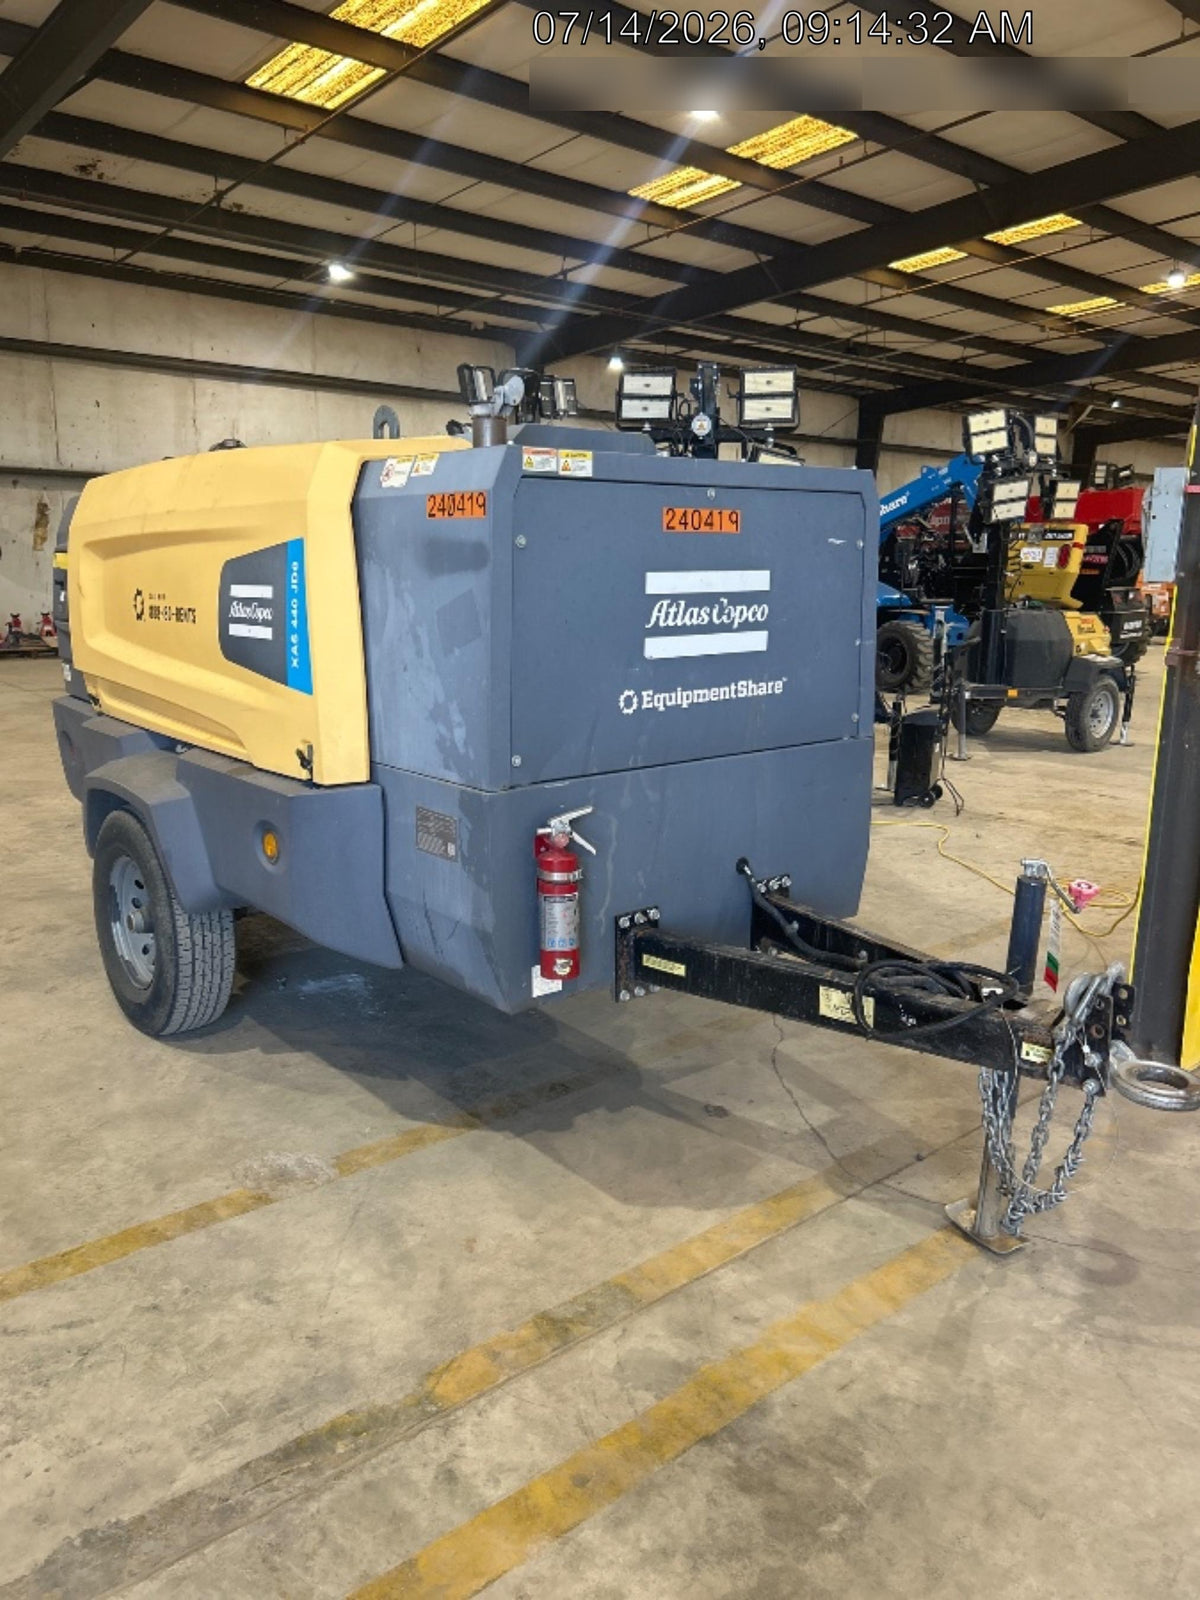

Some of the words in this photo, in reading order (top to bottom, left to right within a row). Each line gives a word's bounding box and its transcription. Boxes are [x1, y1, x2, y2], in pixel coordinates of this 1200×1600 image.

[428, 492, 485, 518] 240419
[666, 508, 738, 532] 240419
[641, 679, 782, 711] EquipmentShare
